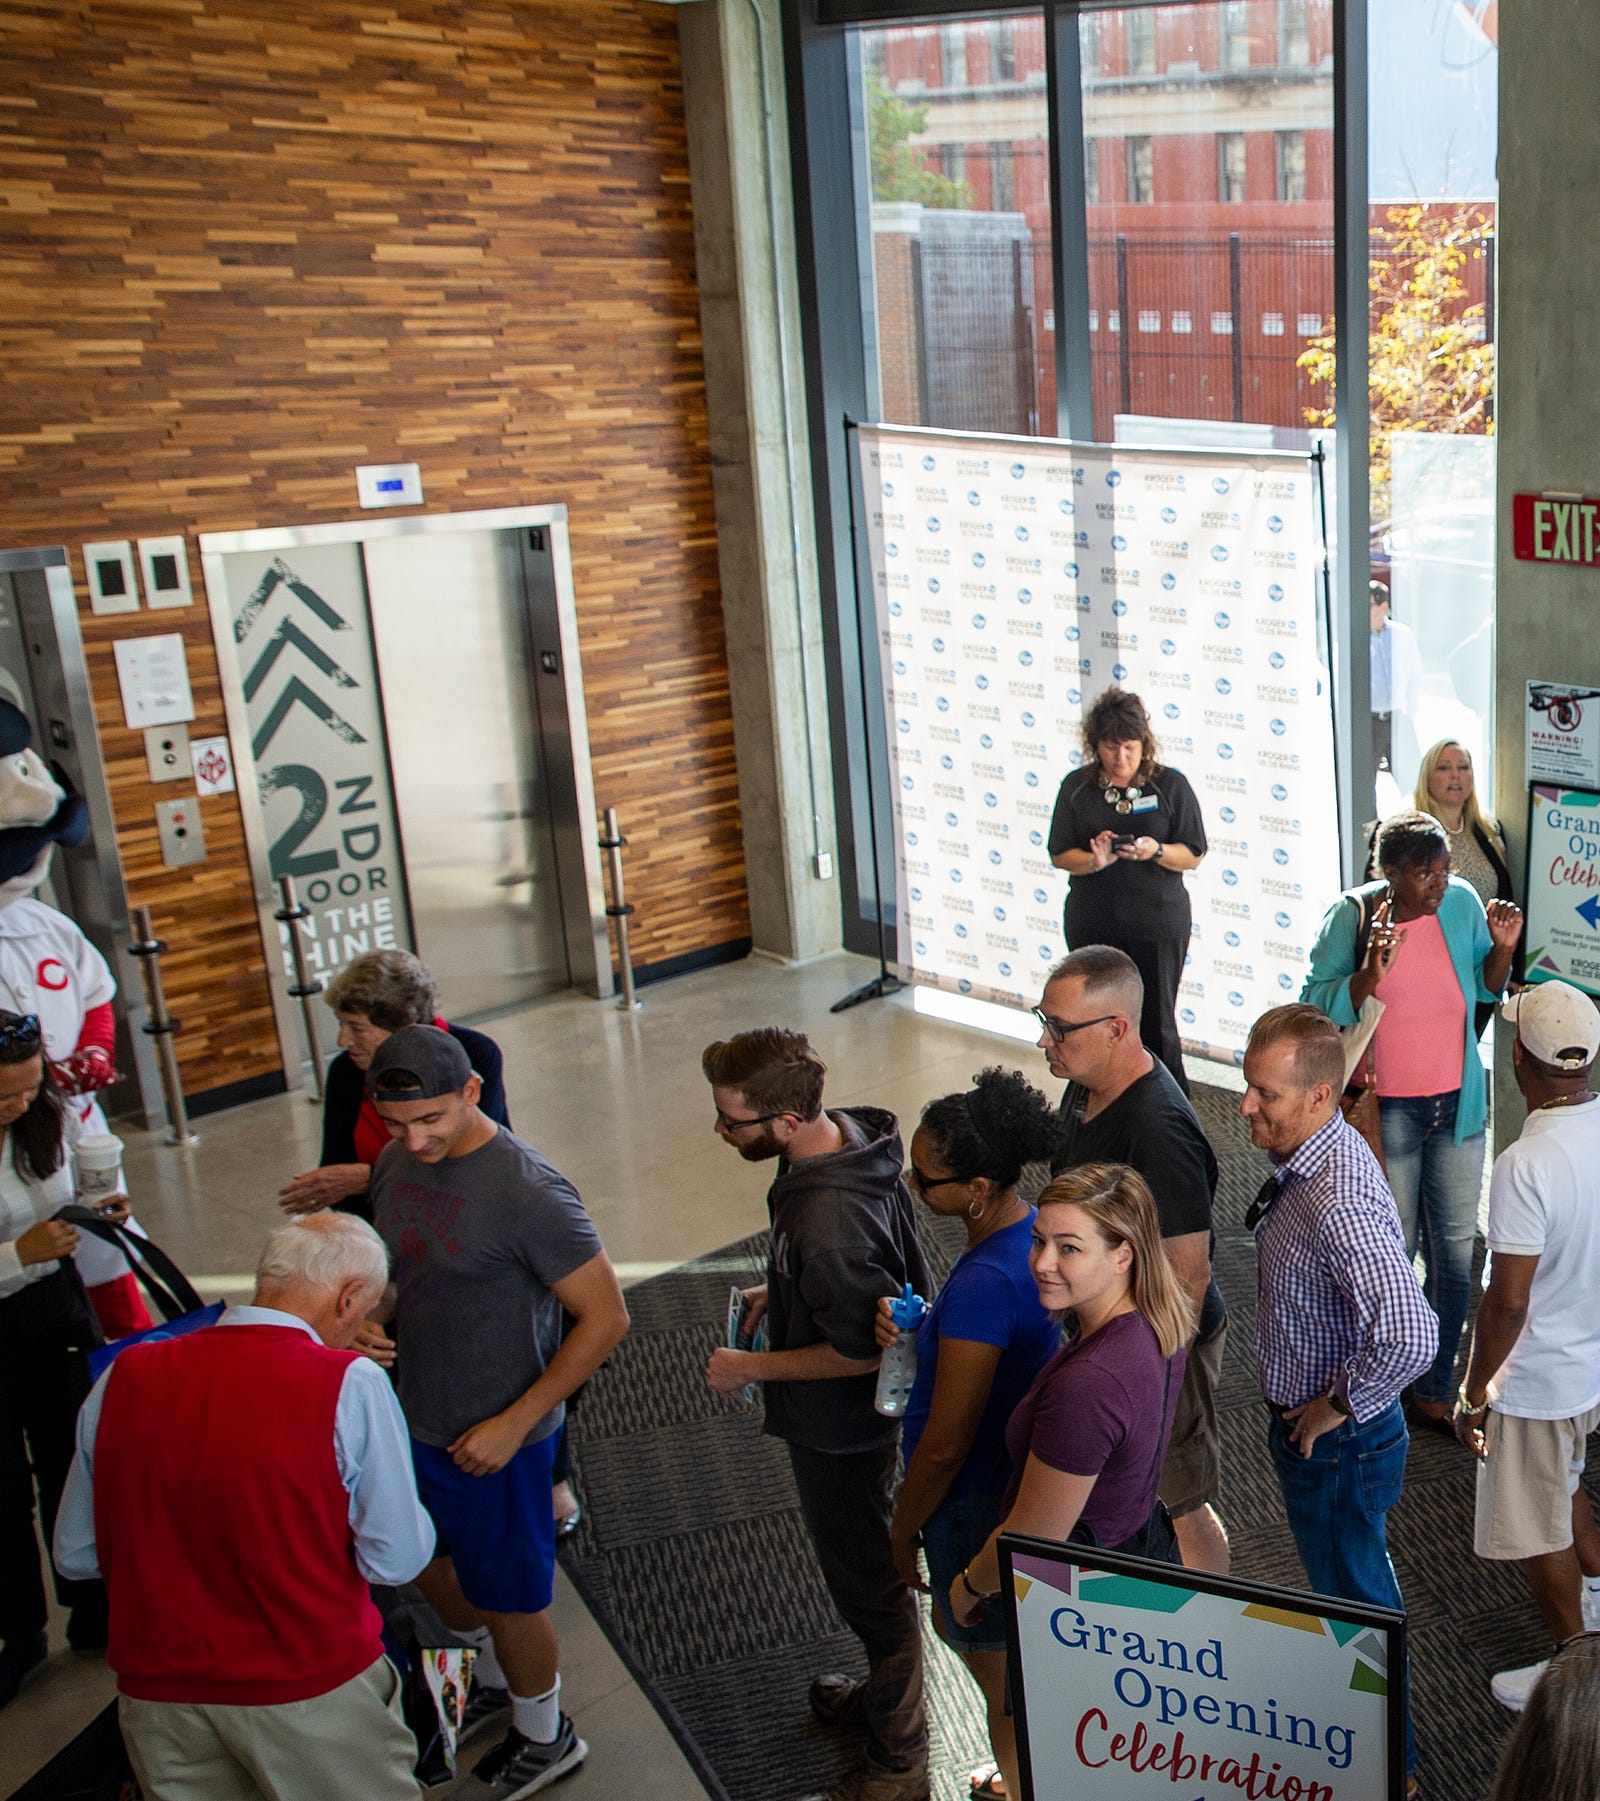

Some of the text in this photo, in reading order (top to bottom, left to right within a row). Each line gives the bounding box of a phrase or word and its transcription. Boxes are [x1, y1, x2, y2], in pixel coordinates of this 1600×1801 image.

[1534, 502, 1597, 562] EXIT
[258, 763, 339, 881] 2
[335, 775, 382, 861] ND
[324, 896, 394, 933] THE
[37, 958, 68, 990] C
[1050, 1607, 1228, 1682] Grand
[1075, 1707, 1334, 1801] Celebration
[1113, 1668, 1356, 1770] Opening
